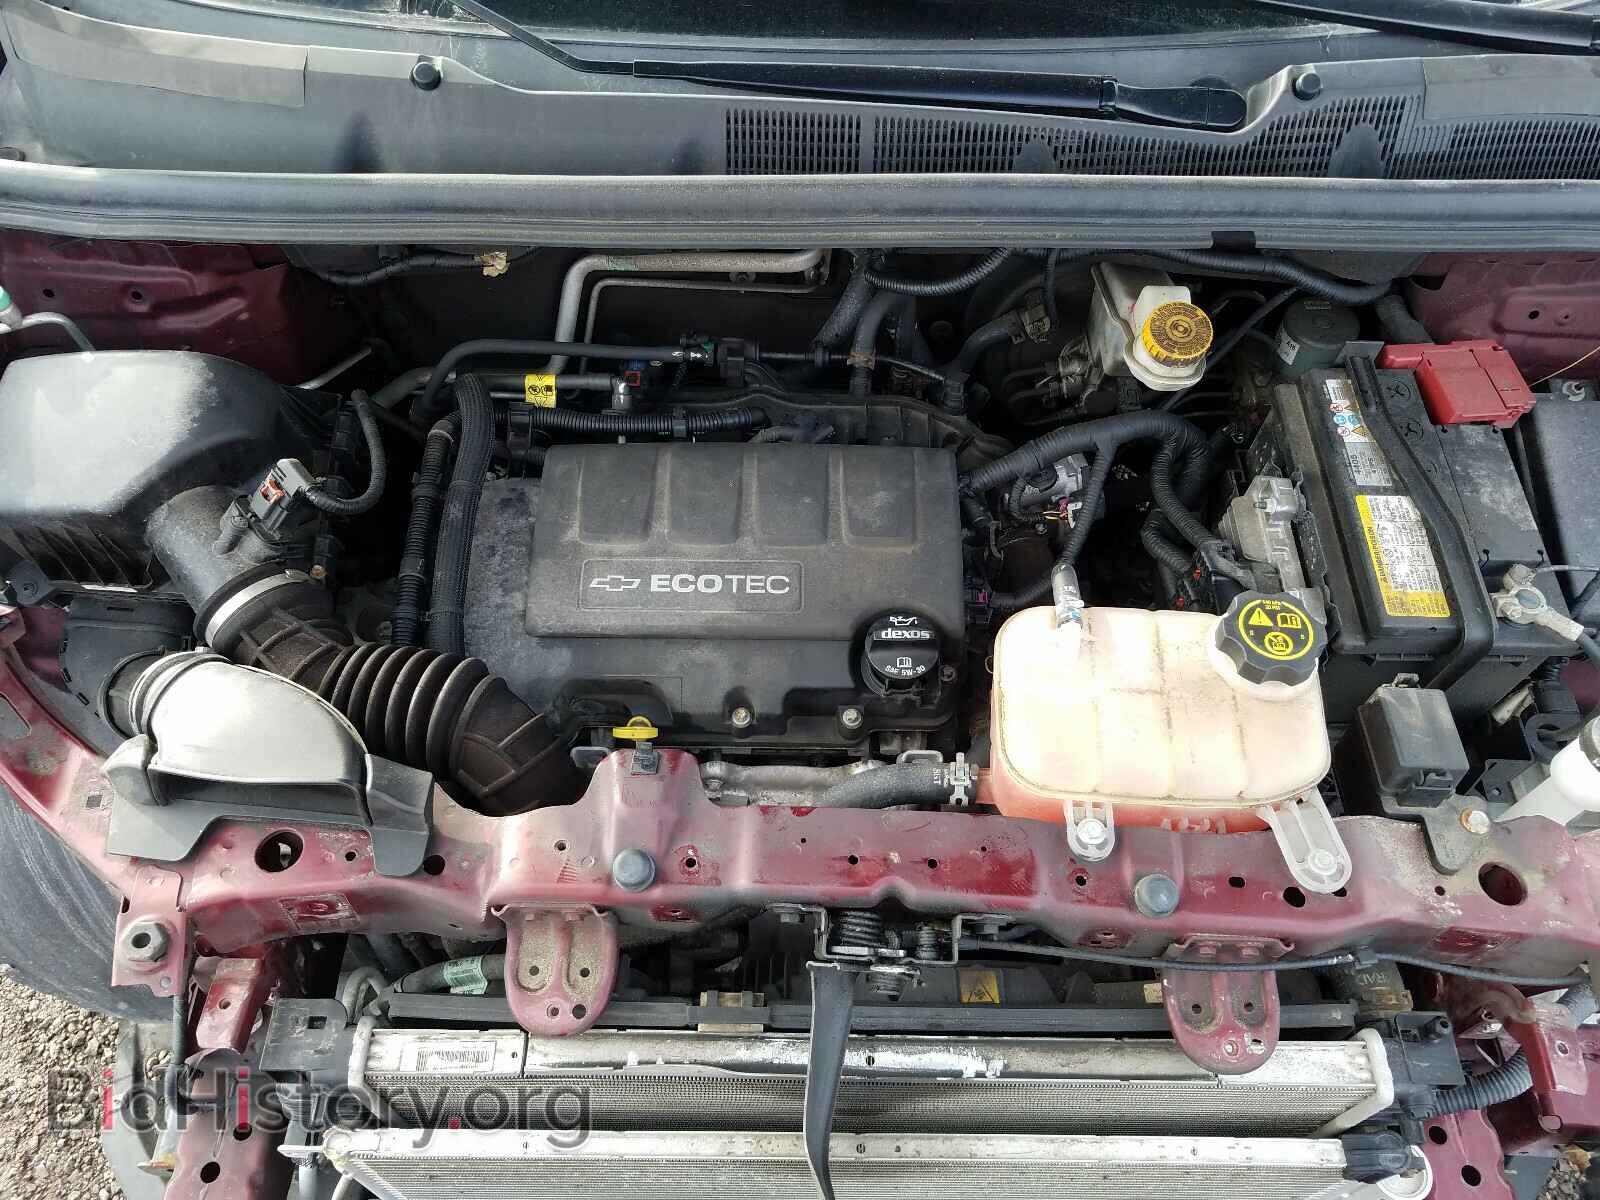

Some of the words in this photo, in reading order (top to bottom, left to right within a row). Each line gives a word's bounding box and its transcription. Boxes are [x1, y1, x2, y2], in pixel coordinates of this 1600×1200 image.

[650, 573, 790, 594] ECOTEC
[881, 628, 930, 639] dexos
[885, 665, 900, 674] SAE
[901, 665, 926, 676] 5W-30
